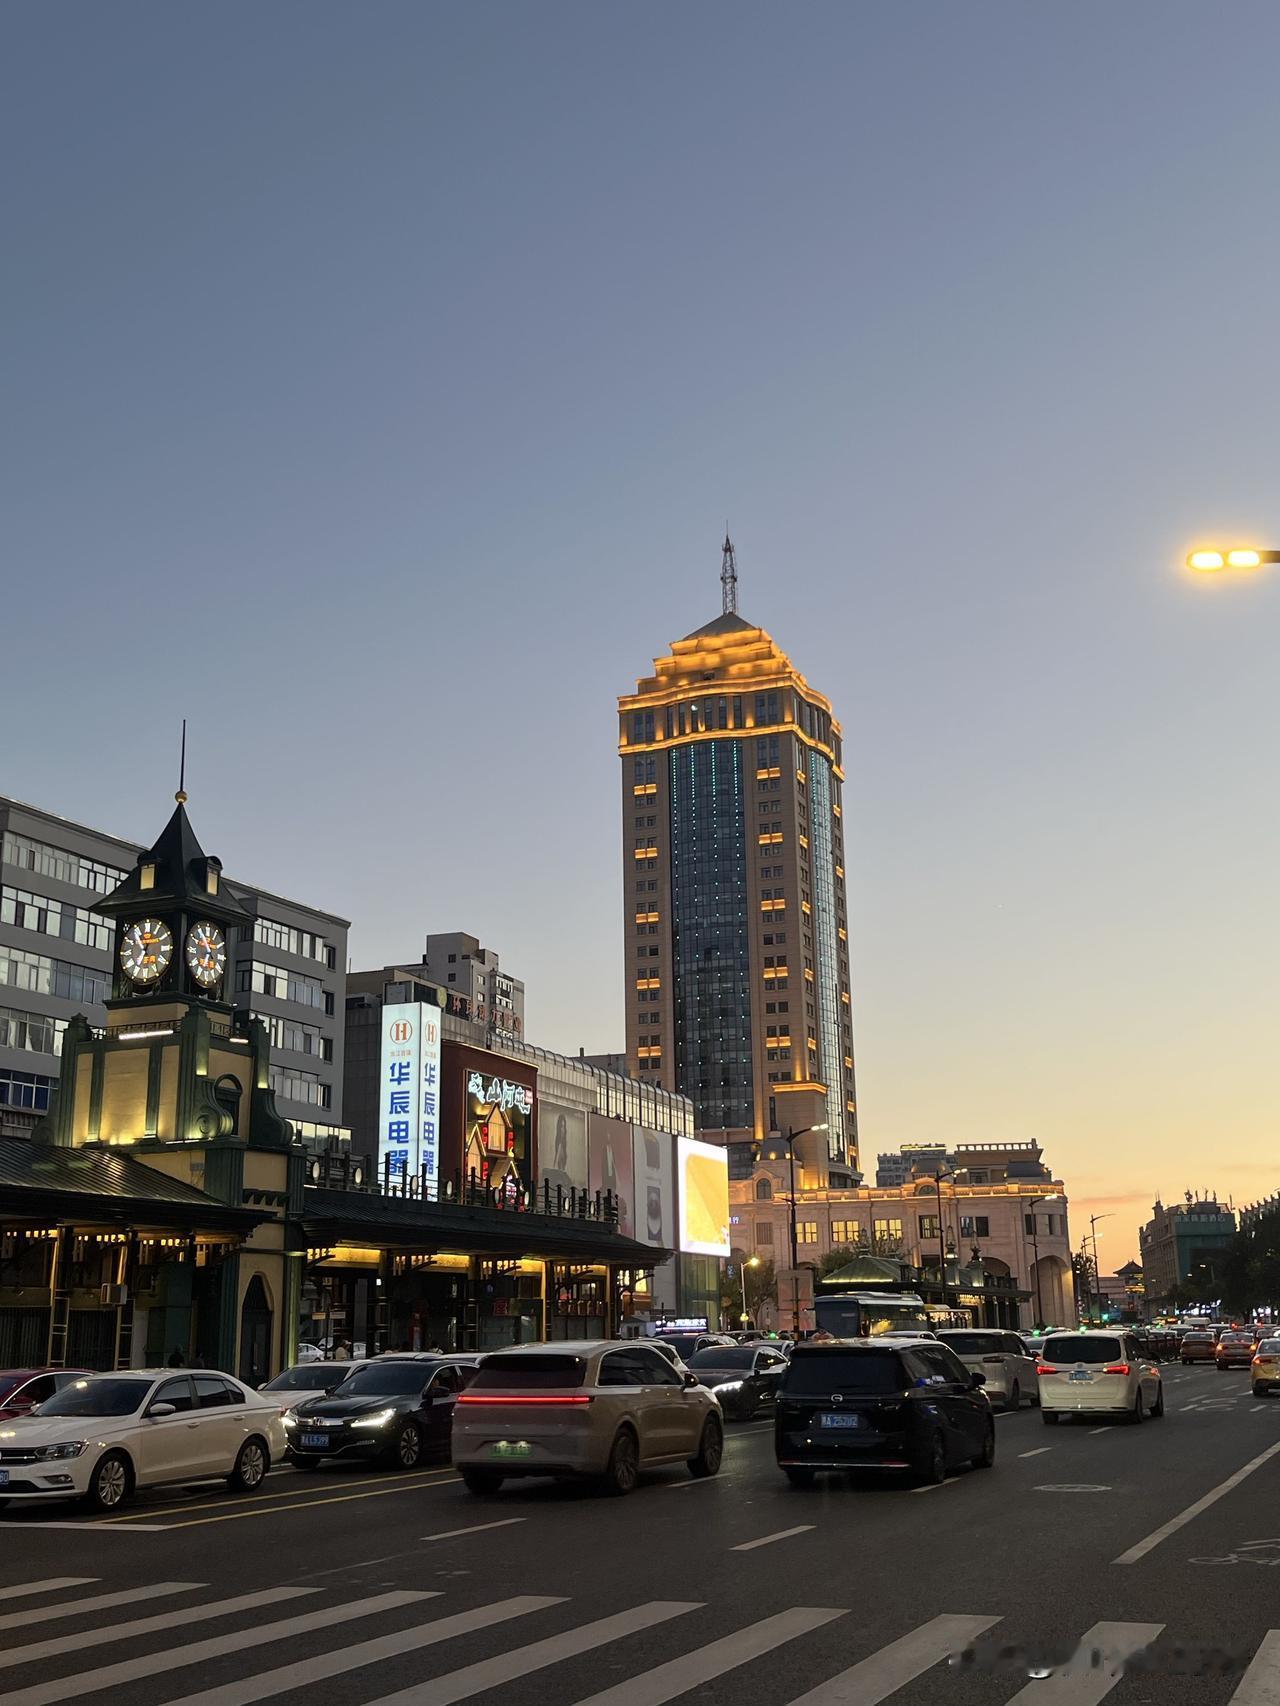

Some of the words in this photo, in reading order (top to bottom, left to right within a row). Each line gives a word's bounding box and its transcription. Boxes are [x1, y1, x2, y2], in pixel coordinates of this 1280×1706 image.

[388, 1061, 411, 1174] 华辰电器
[422, 1063, 436, 1175] 华辰电器
